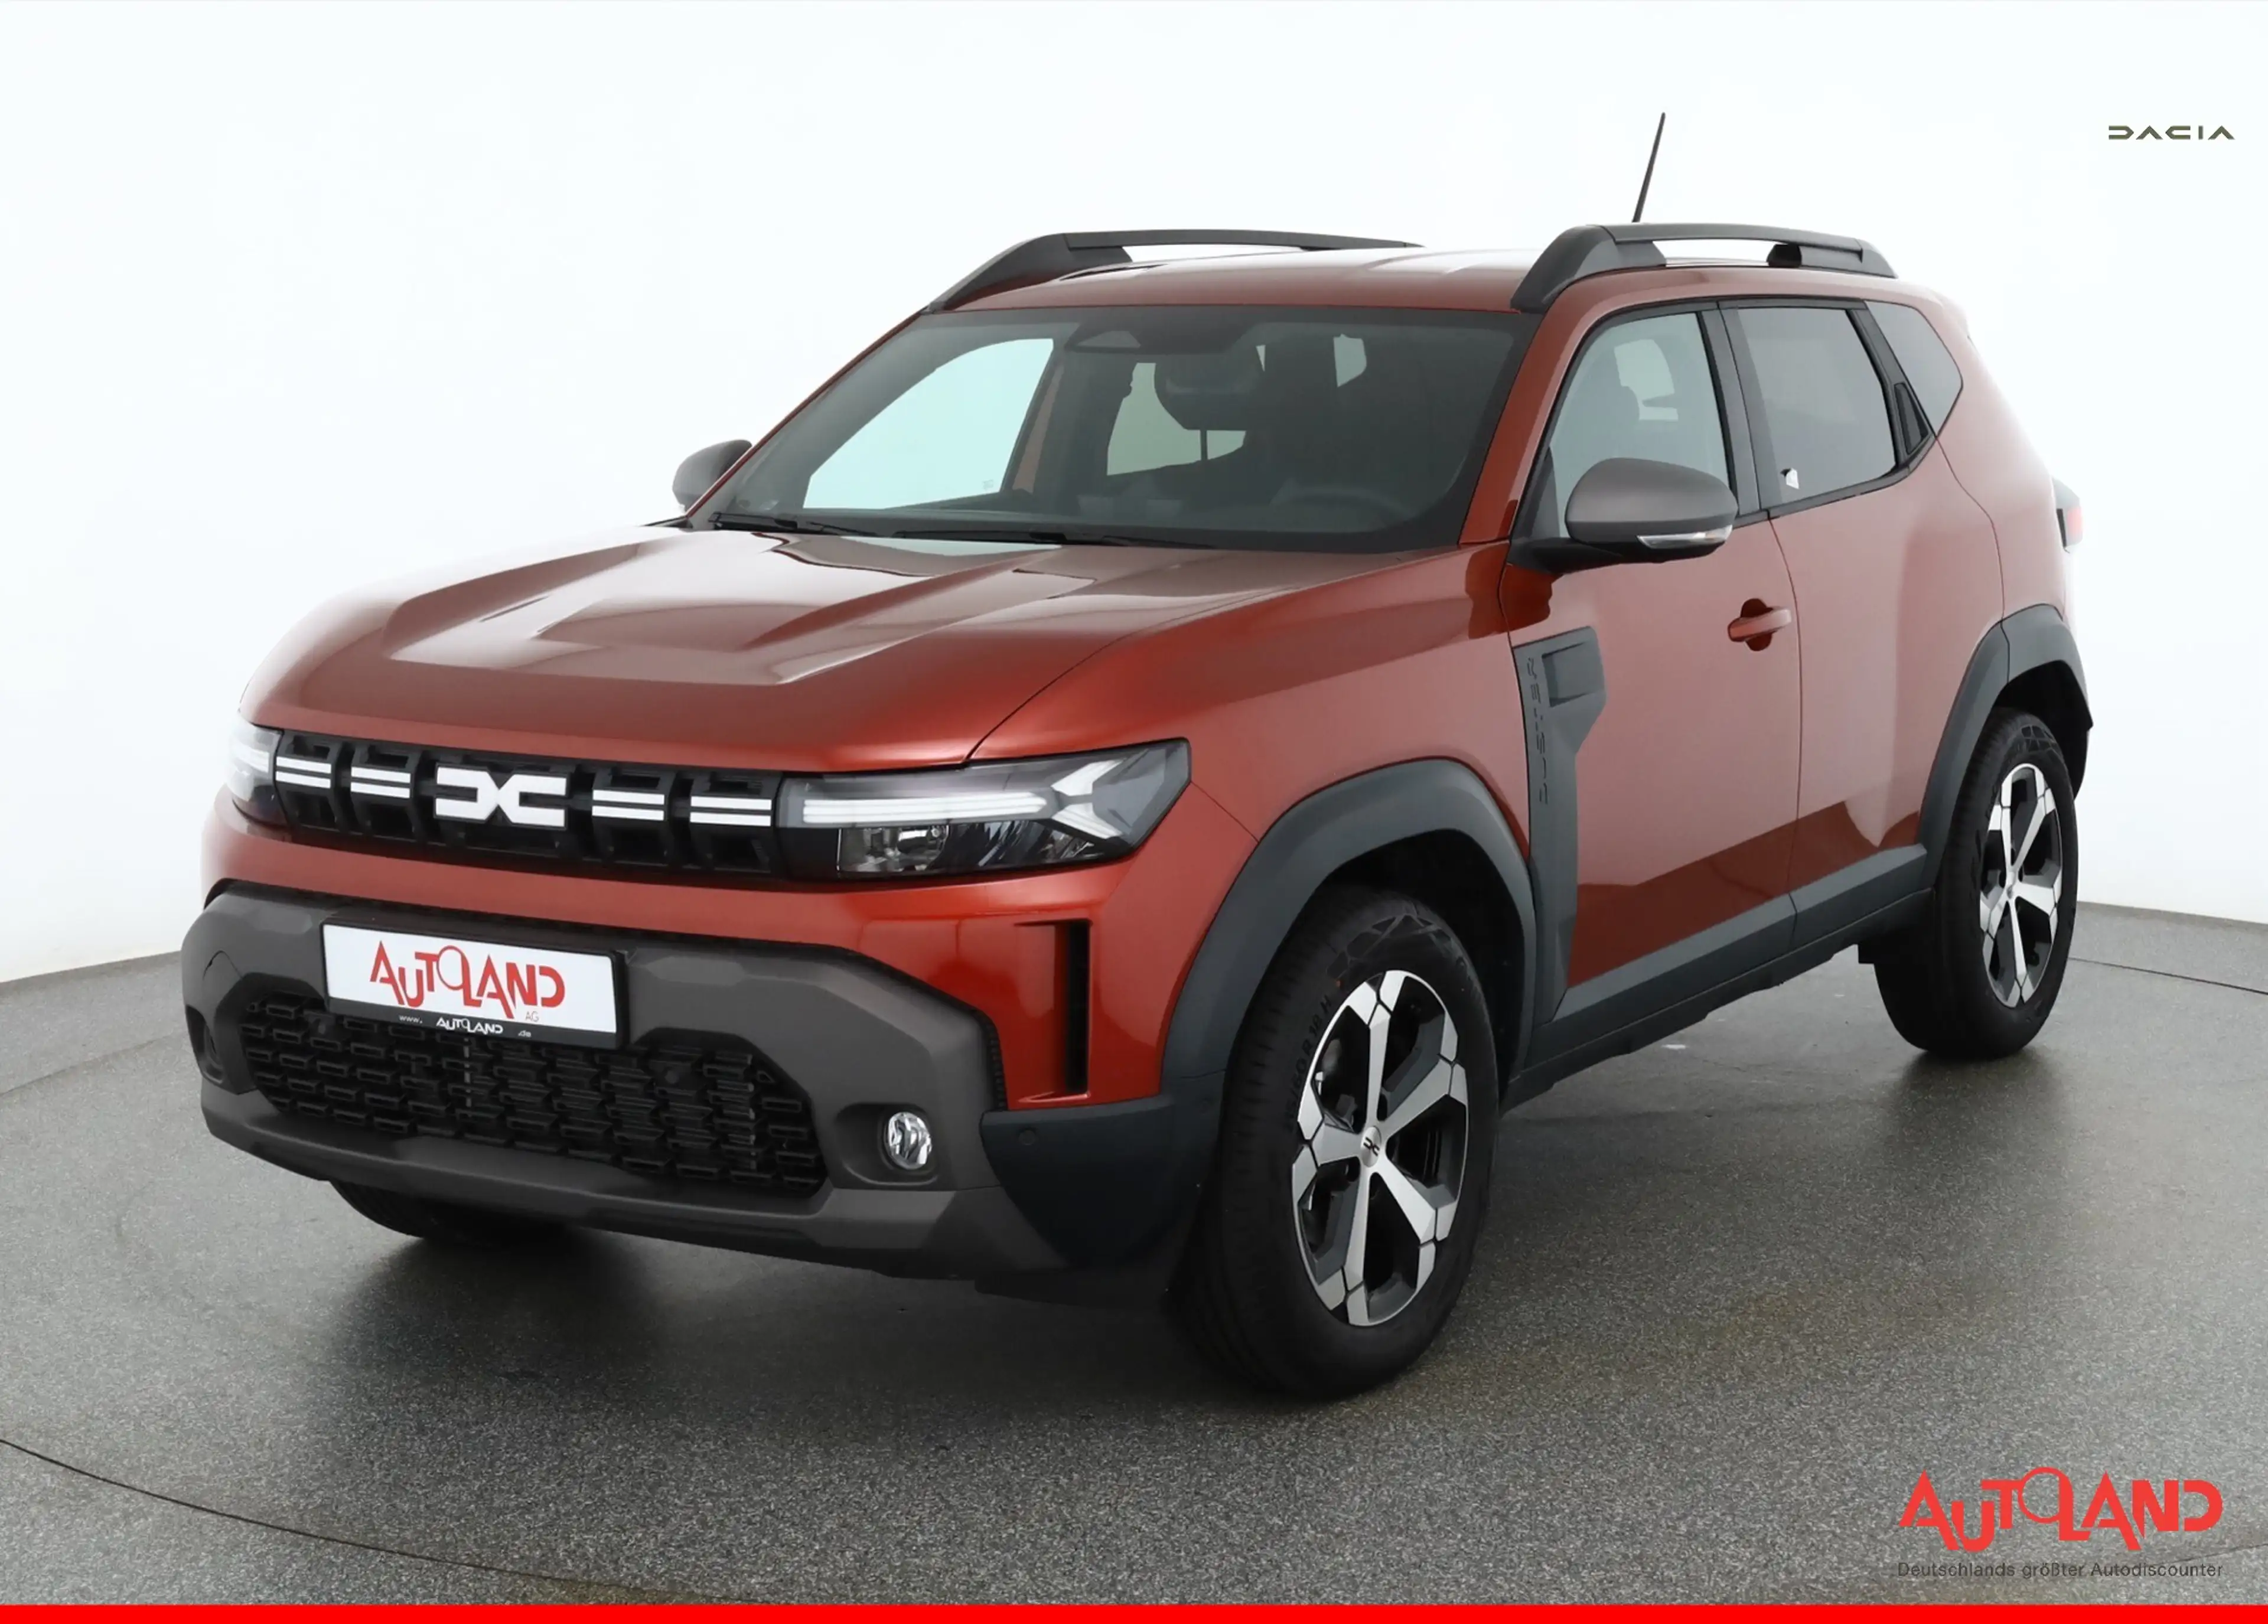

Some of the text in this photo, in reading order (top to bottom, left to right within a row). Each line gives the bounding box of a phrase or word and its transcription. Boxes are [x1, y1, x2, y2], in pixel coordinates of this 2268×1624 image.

[370, 940, 565, 1019] AUTOLAND
[399, 1015, 423, 1023] www.
[525, 1010, 540, 1023] AG
